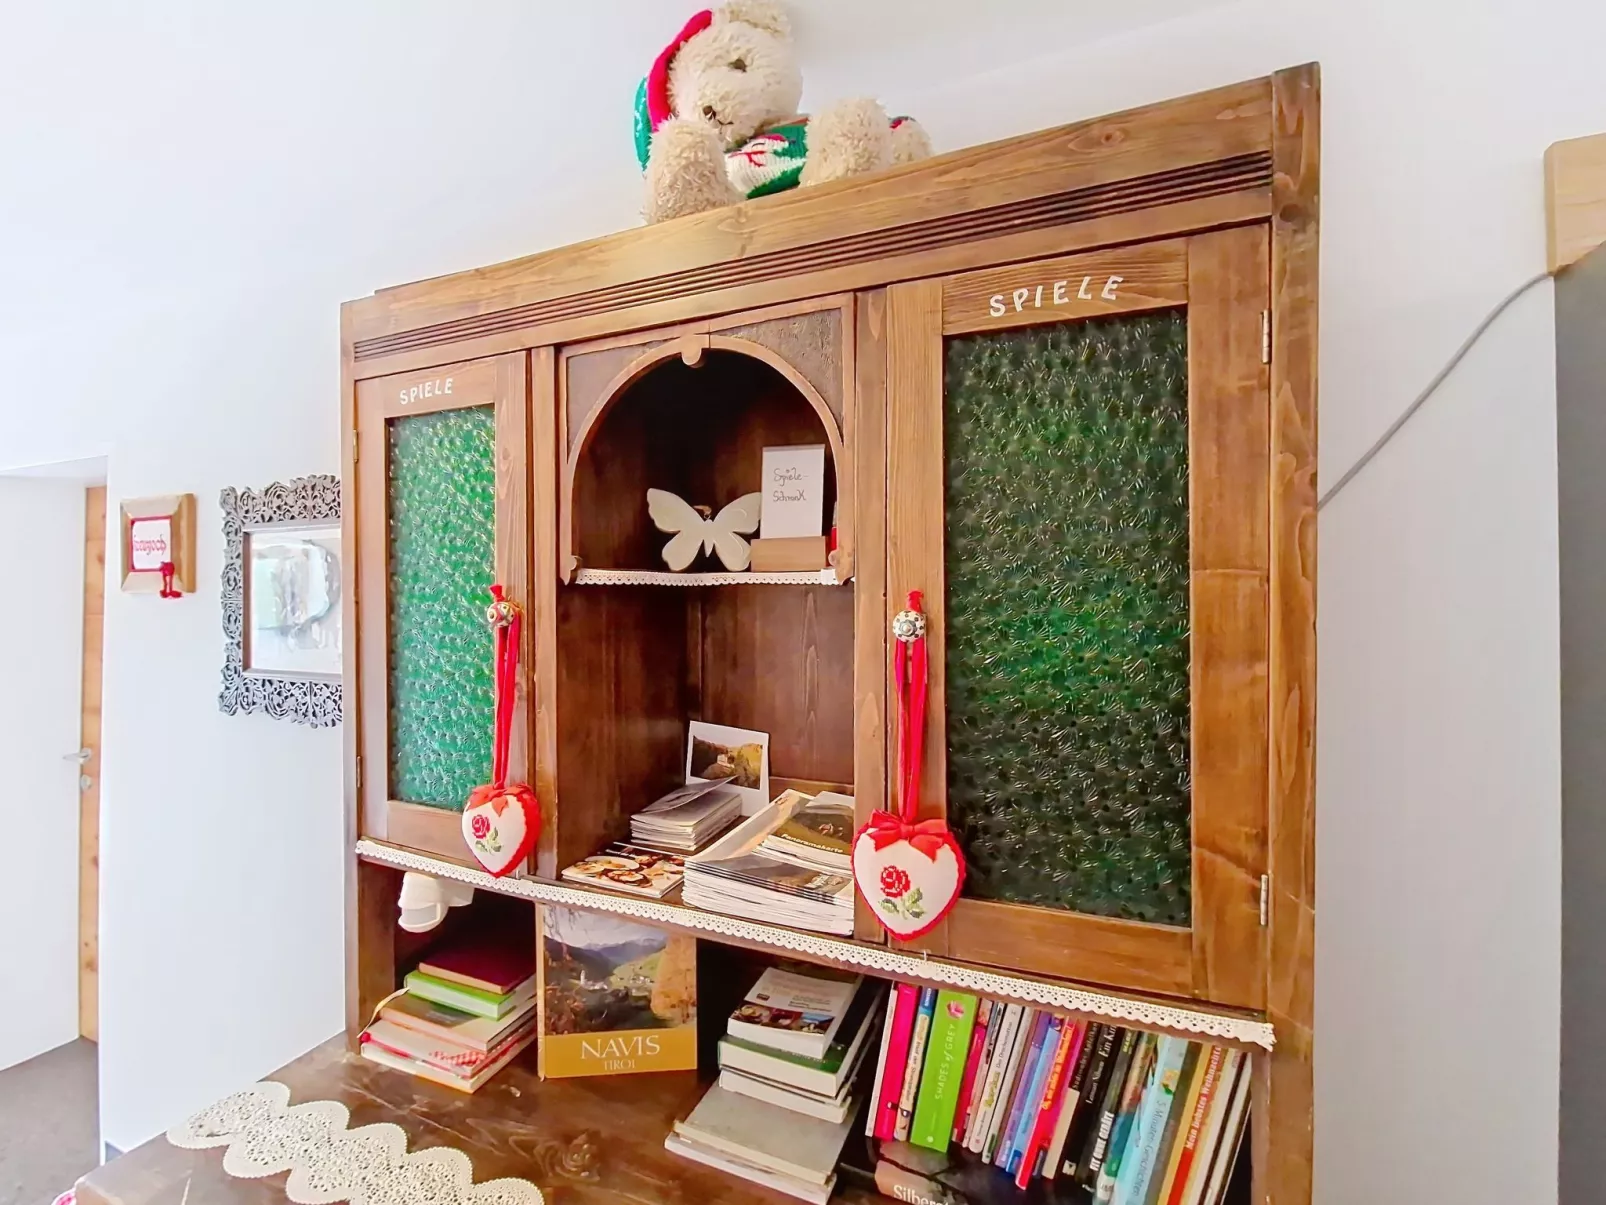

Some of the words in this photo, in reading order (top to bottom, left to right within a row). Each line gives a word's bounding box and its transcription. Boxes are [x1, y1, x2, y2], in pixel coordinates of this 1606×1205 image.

[989, 275, 1124, 317] SPIELE
[399, 378, 453, 405] SPIELE
[581, 1035, 660, 1059] NAVIS
[935, 1062, 949, 1099] SHADES
[945, 1023, 956, 1050] GREY
[1184, 1128, 1198, 1150] Mein
[1089, 1157, 1101, 1171] FIT
